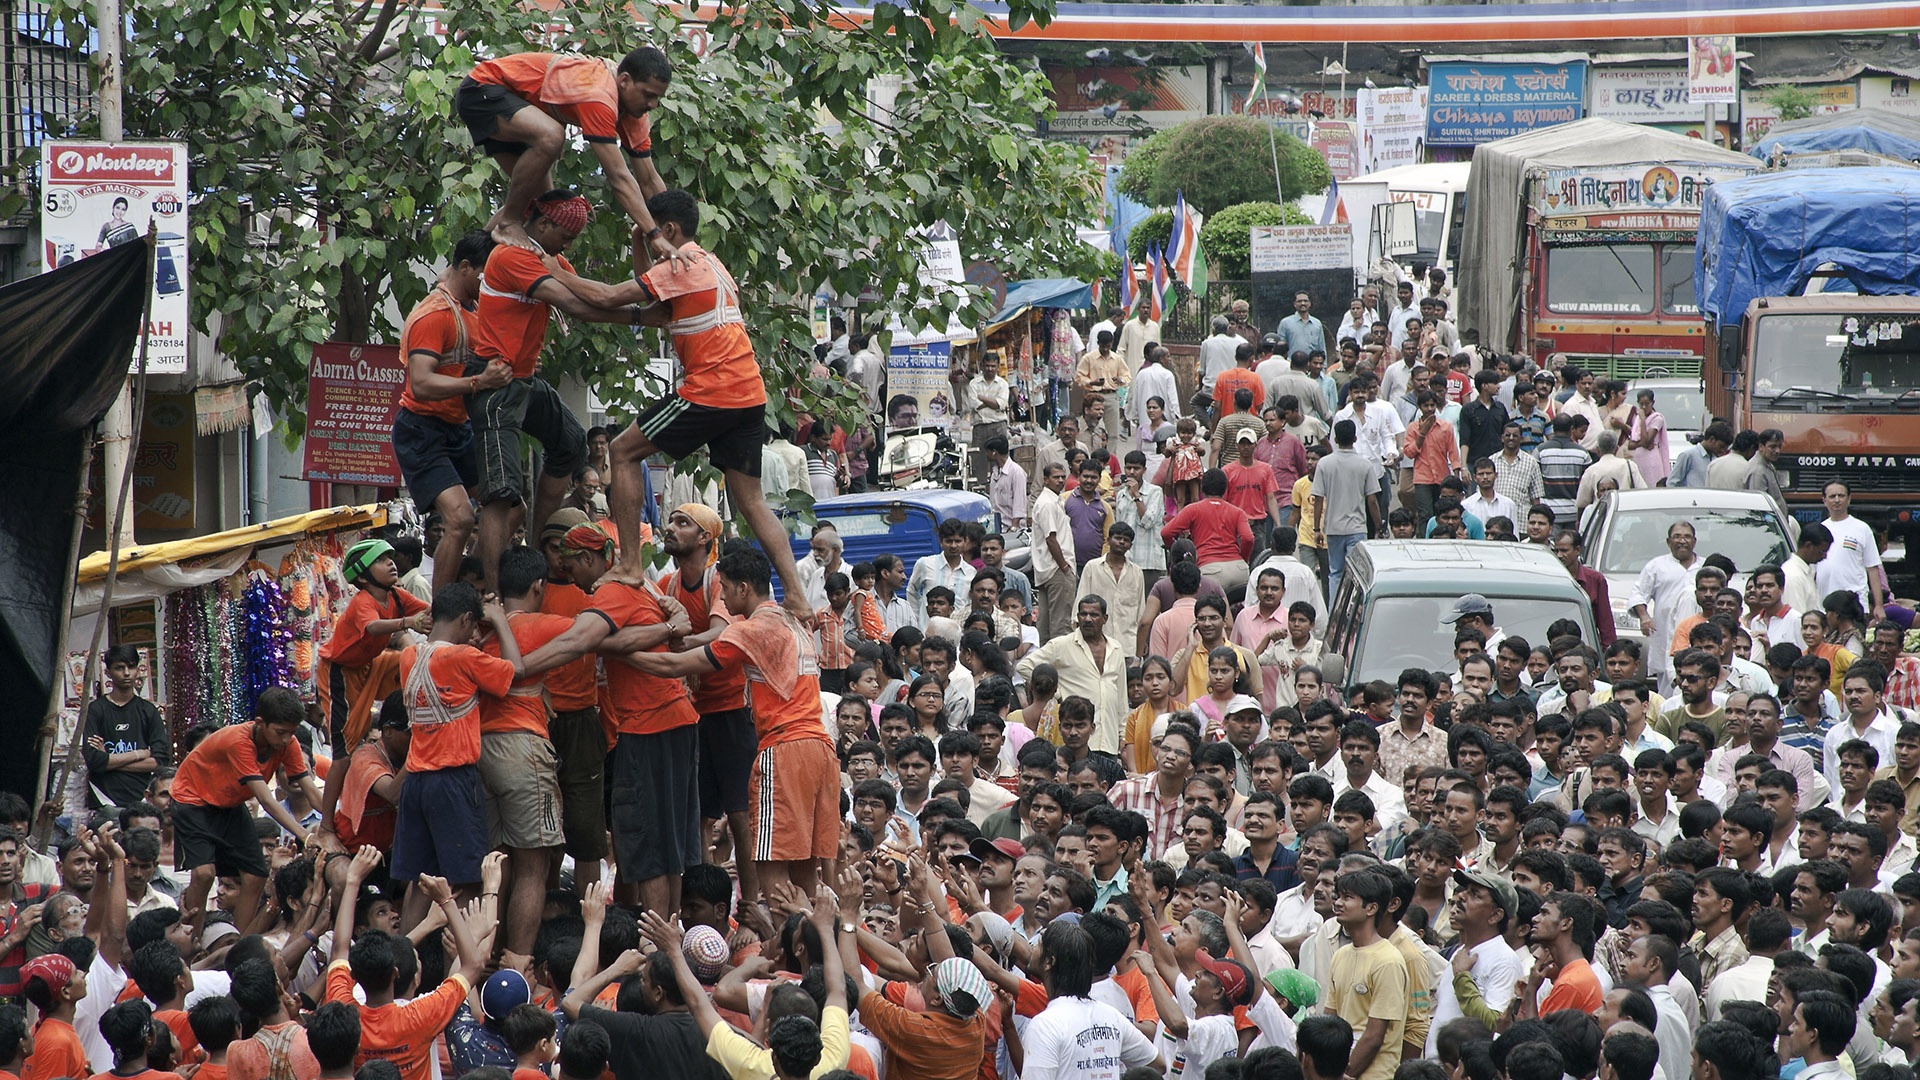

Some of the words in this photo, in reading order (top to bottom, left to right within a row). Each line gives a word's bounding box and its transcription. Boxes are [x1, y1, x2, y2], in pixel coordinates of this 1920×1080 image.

[1446, 68, 1506, 92] राजेश
[1513, 68, 1569, 92] स्टोर्स
[1692, 86, 1734, 94] SUVIDHA
[1434, 93, 1471, 102] SAREE
[1474, 94, 1481, 102] &
[1484, 93, 1520, 102] DRESS
[1524, 92, 1578, 101] MATERIAL
[1433, 107, 1506, 127] Chhaya
[1474, 128, 1509, 136] SHIRTING
[86, 152, 169, 176] Navdeep
[82, 185, 102, 197] ATTA
[106, 184, 140, 198] MASTER
[1561, 177, 1577, 206] श्री
[46, 194, 58, 212] 5
[156, 202, 178, 213] 9001
[1618, 216, 1664, 228] AMBIKA
[1558, 303, 1578, 312] NEW
[1580, 303, 1641, 312] AMBIKA
[1674, 304, 1699, 312] TRA
[148, 340, 184, 348] 4376184
[157, 356, 184, 365] आटा
[312, 356, 355, 380] ADITYA
[357, 360, 405, 384] CLASSES
[324, 394, 362, 402] COMMERCE
[325, 402, 352, 410] FREE
[356, 405, 388, 413] DEMO
[330, 412, 384, 422] LECTURES
[309, 429, 334, 438] ONLY
[336, 430, 350, 439] 20
[328, 441, 347, 450] PER
[349, 443, 380, 452] BATCH
[1798, 456, 1836, 466] GOODS
[1845, 457, 1896, 466] TATA
